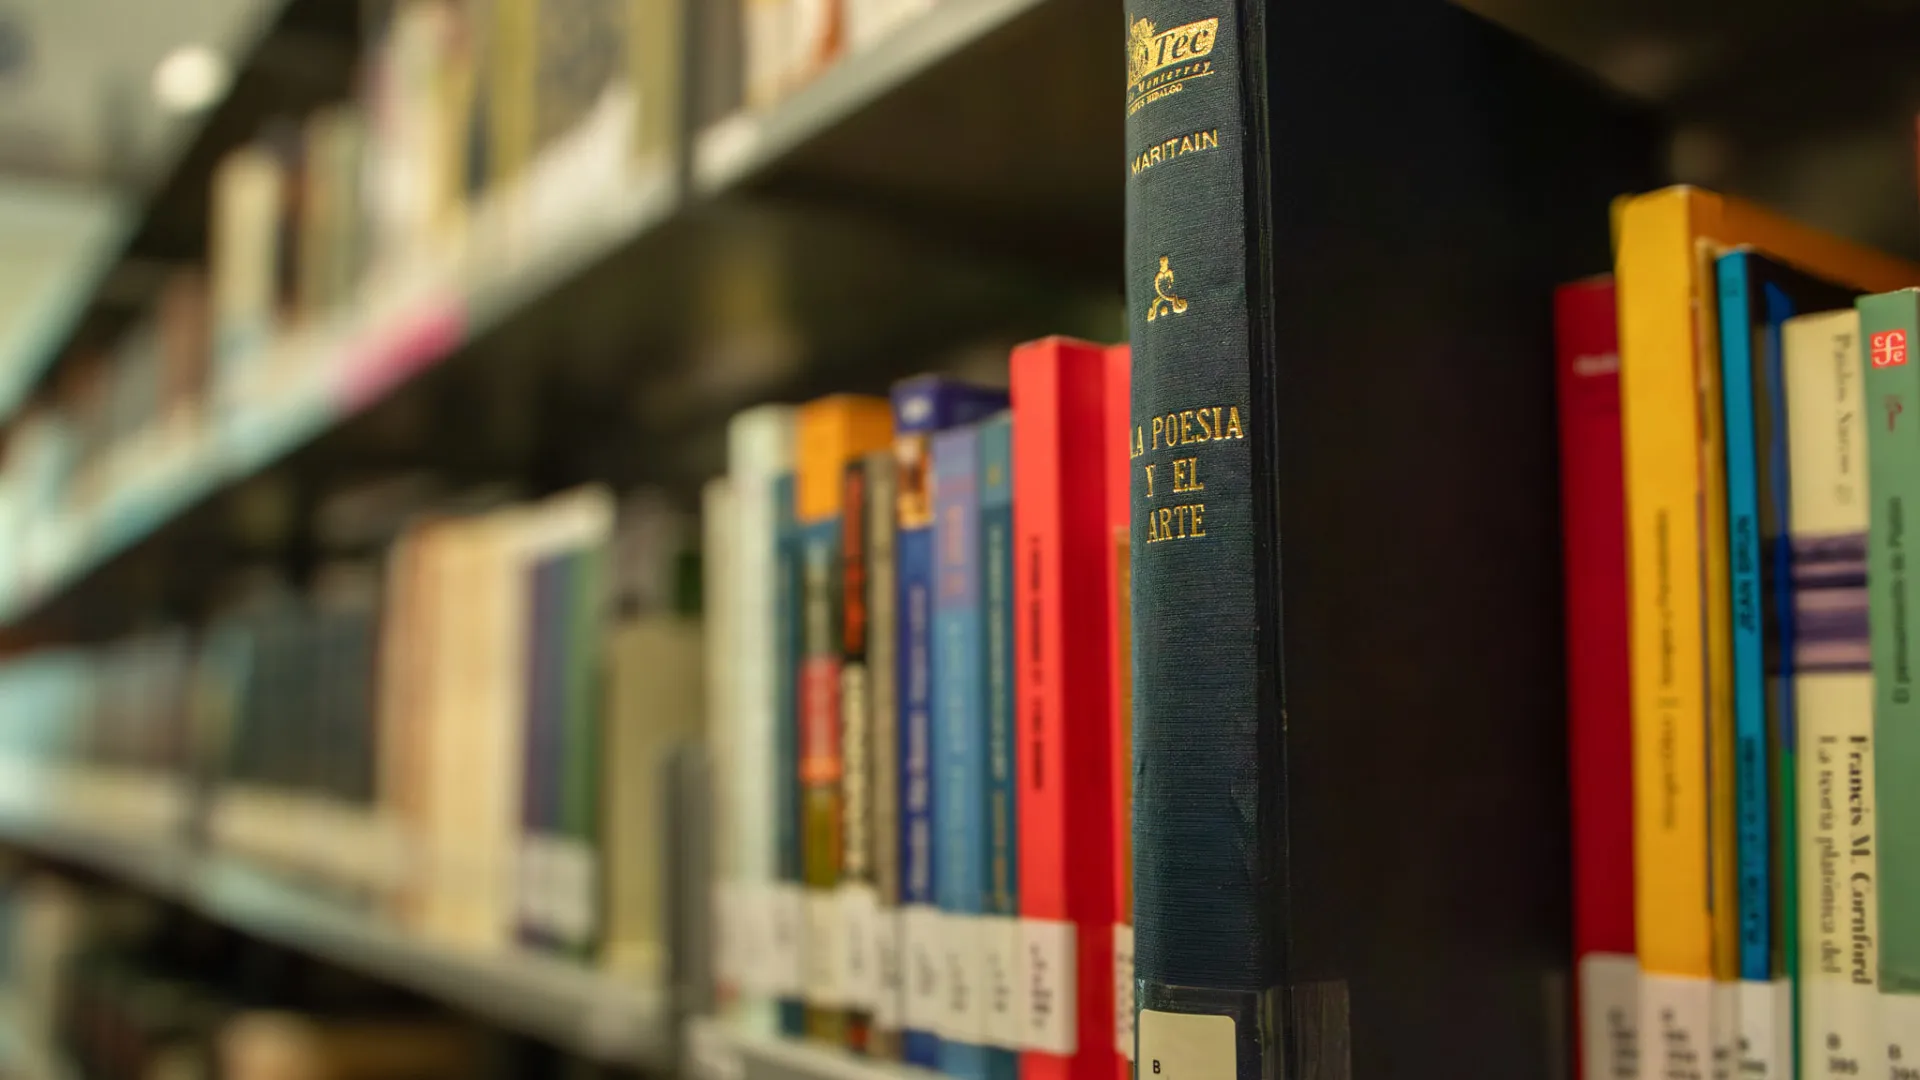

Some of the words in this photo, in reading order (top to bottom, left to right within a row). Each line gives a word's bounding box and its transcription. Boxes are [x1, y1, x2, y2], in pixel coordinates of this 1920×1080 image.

[1154, 29, 1209, 67] Tec
[1137, 60, 1212, 93] Monterrey
[1131, 129, 1219, 176] MARITAIN
[1130, 425, 1144, 459] LA
[1151, 405, 1245, 451] POESIA
[1145, 464, 1157, 498] Y
[1173, 457, 1205, 493] EL
[1147, 504, 1207, 544] ARTE
[1848, 735, 1870, 826] Francis
[1850, 834, 1871, 865] M.
[1850, 870, 1873, 985] Cornford
[1153, 1059, 1161, 1074] B
